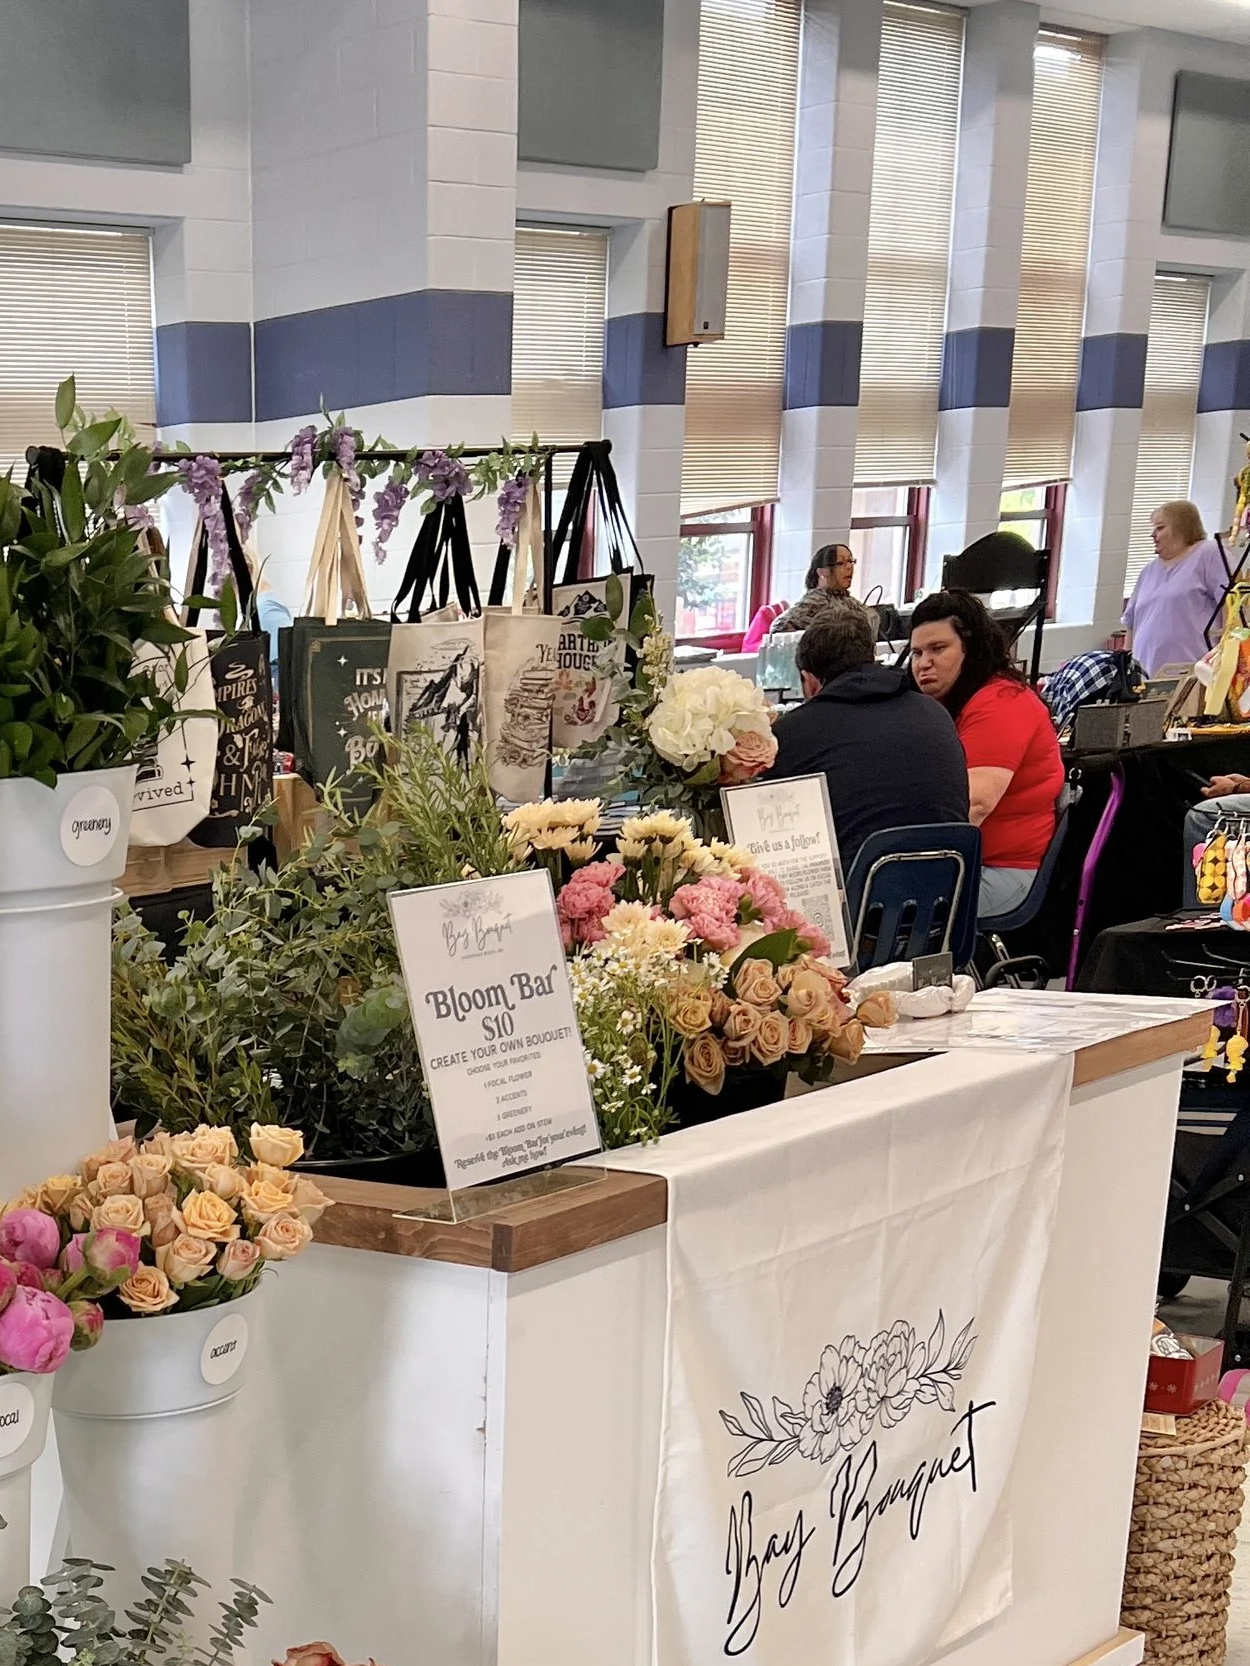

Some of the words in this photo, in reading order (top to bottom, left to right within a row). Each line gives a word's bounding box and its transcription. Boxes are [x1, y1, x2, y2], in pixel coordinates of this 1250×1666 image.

[71, 817, 112, 840] greenery
[772, 841, 783, 852] us
[425, 983, 516, 1022] Bloom
[510, 964, 558, 1001] Bar
[481, 1011, 515, 1043] $10
[430, 1051, 469, 1070] CREATE
[470, 1044, 498, 1060] YOUR
[499, 1037, 525, 1054] OWN
[526, 1026, 573, 1047] BOUQUET!
[466, 1063, 491, 1076] CHOOSE
[492, 1058, 509, 1070] YOUR
[487, 1078, 507, 1089] FOCAL
[508, 1070, 533, 1083] FLOWER
[501, 1089, 528, 1103] ACCENTS
[501, 1105, 532, 1120] GREENERY
[496, 1128, 513, 1140] EACH
[513, 1124, 526, 1135] ADD
[526, 1121, 536, 1131] ON
[536, 1117, 552, 1129] STEM
[453, 1151, 486, 1170] Reserve
[486, 1149, 499, 1162] the
[499, 1143, 526, 1157] Bloom
[210, 1339, 238, 1360] accent
[723, 1489, 816, 1657] Bay
[829, 1399, 997, 1599] Bouquet
